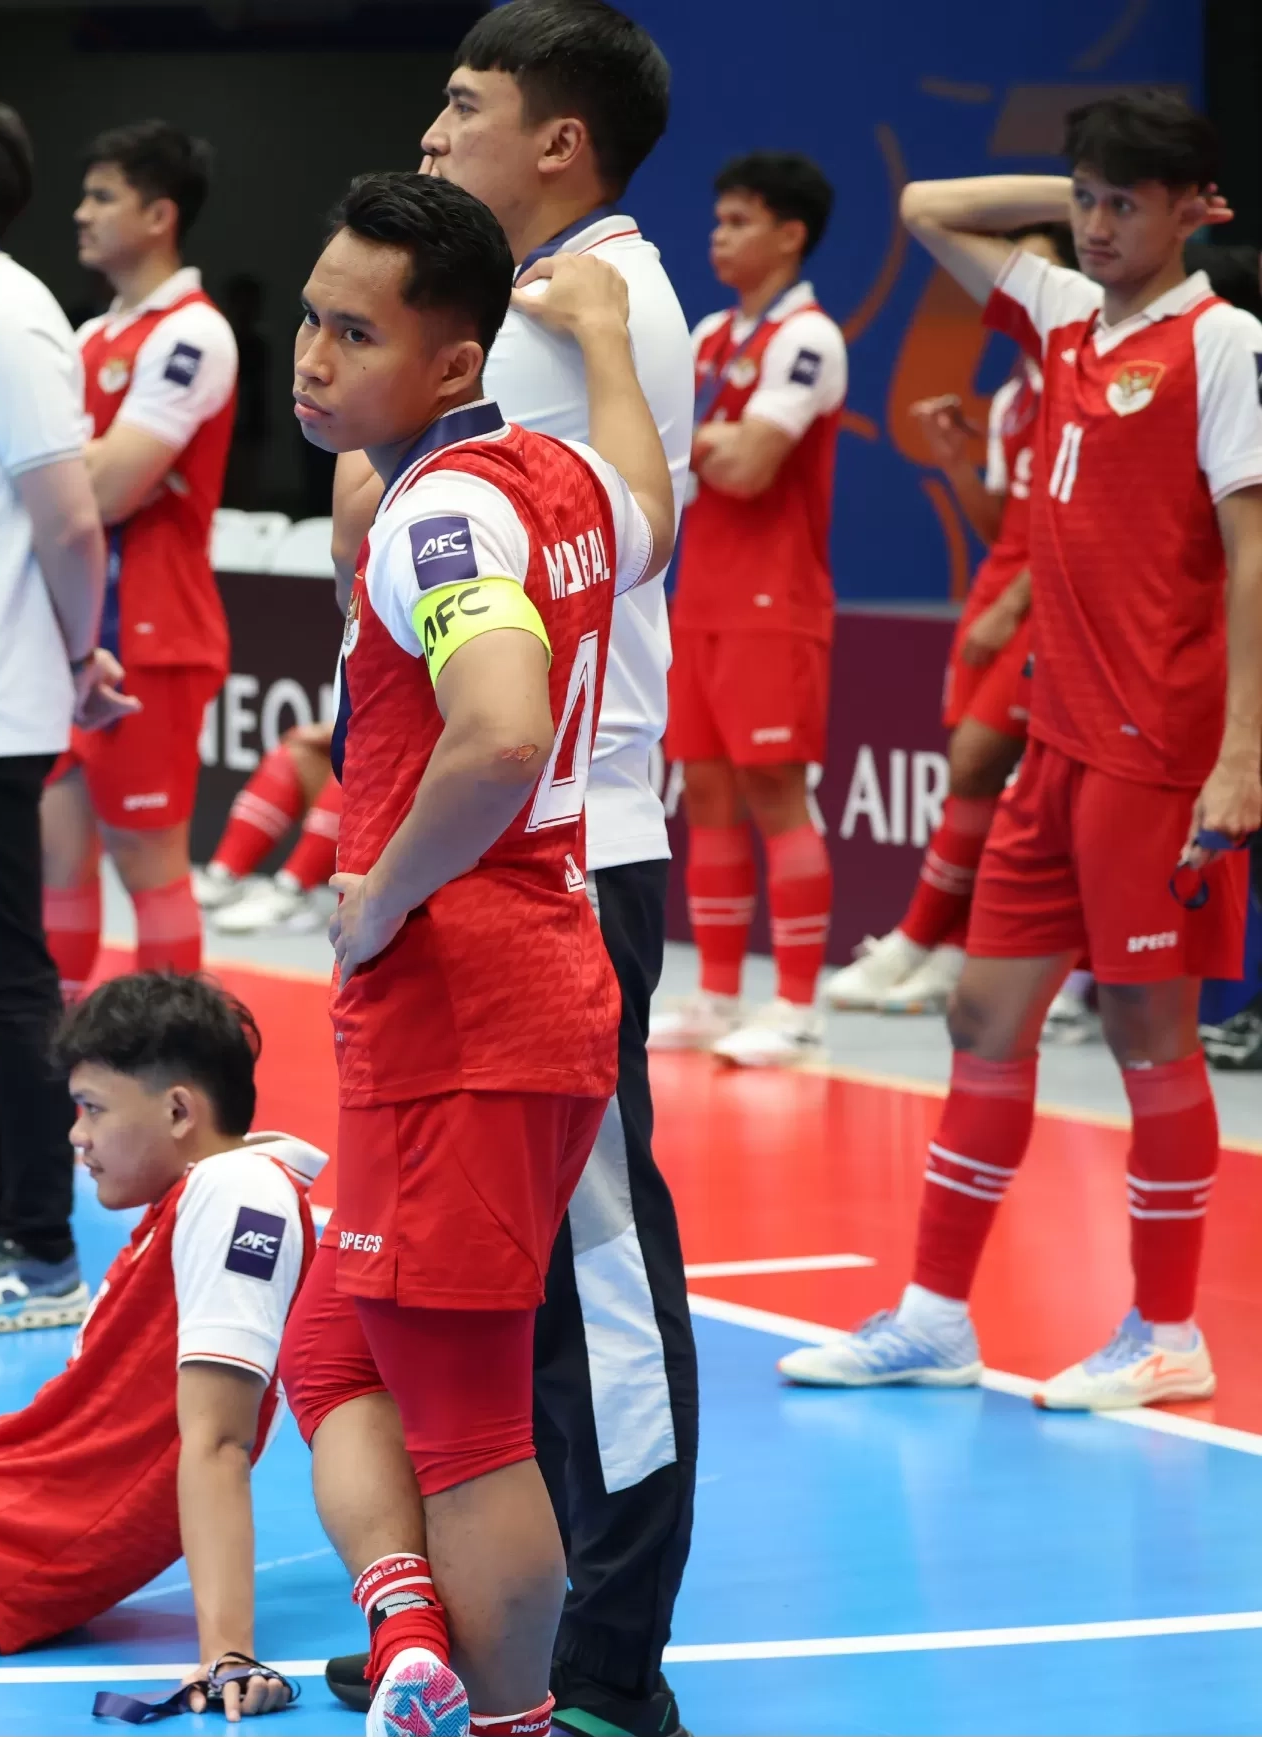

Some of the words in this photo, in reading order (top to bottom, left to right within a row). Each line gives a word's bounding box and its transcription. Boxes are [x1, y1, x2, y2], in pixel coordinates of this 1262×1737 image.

[1049, 422, 1083, 504] 11
[417, 530, 466, 559] AFC
[425, 586, 490, 664] AFC
[234, 1230, 278, 1254] AFC
[339, 1231, 383, 1253] SPECS
